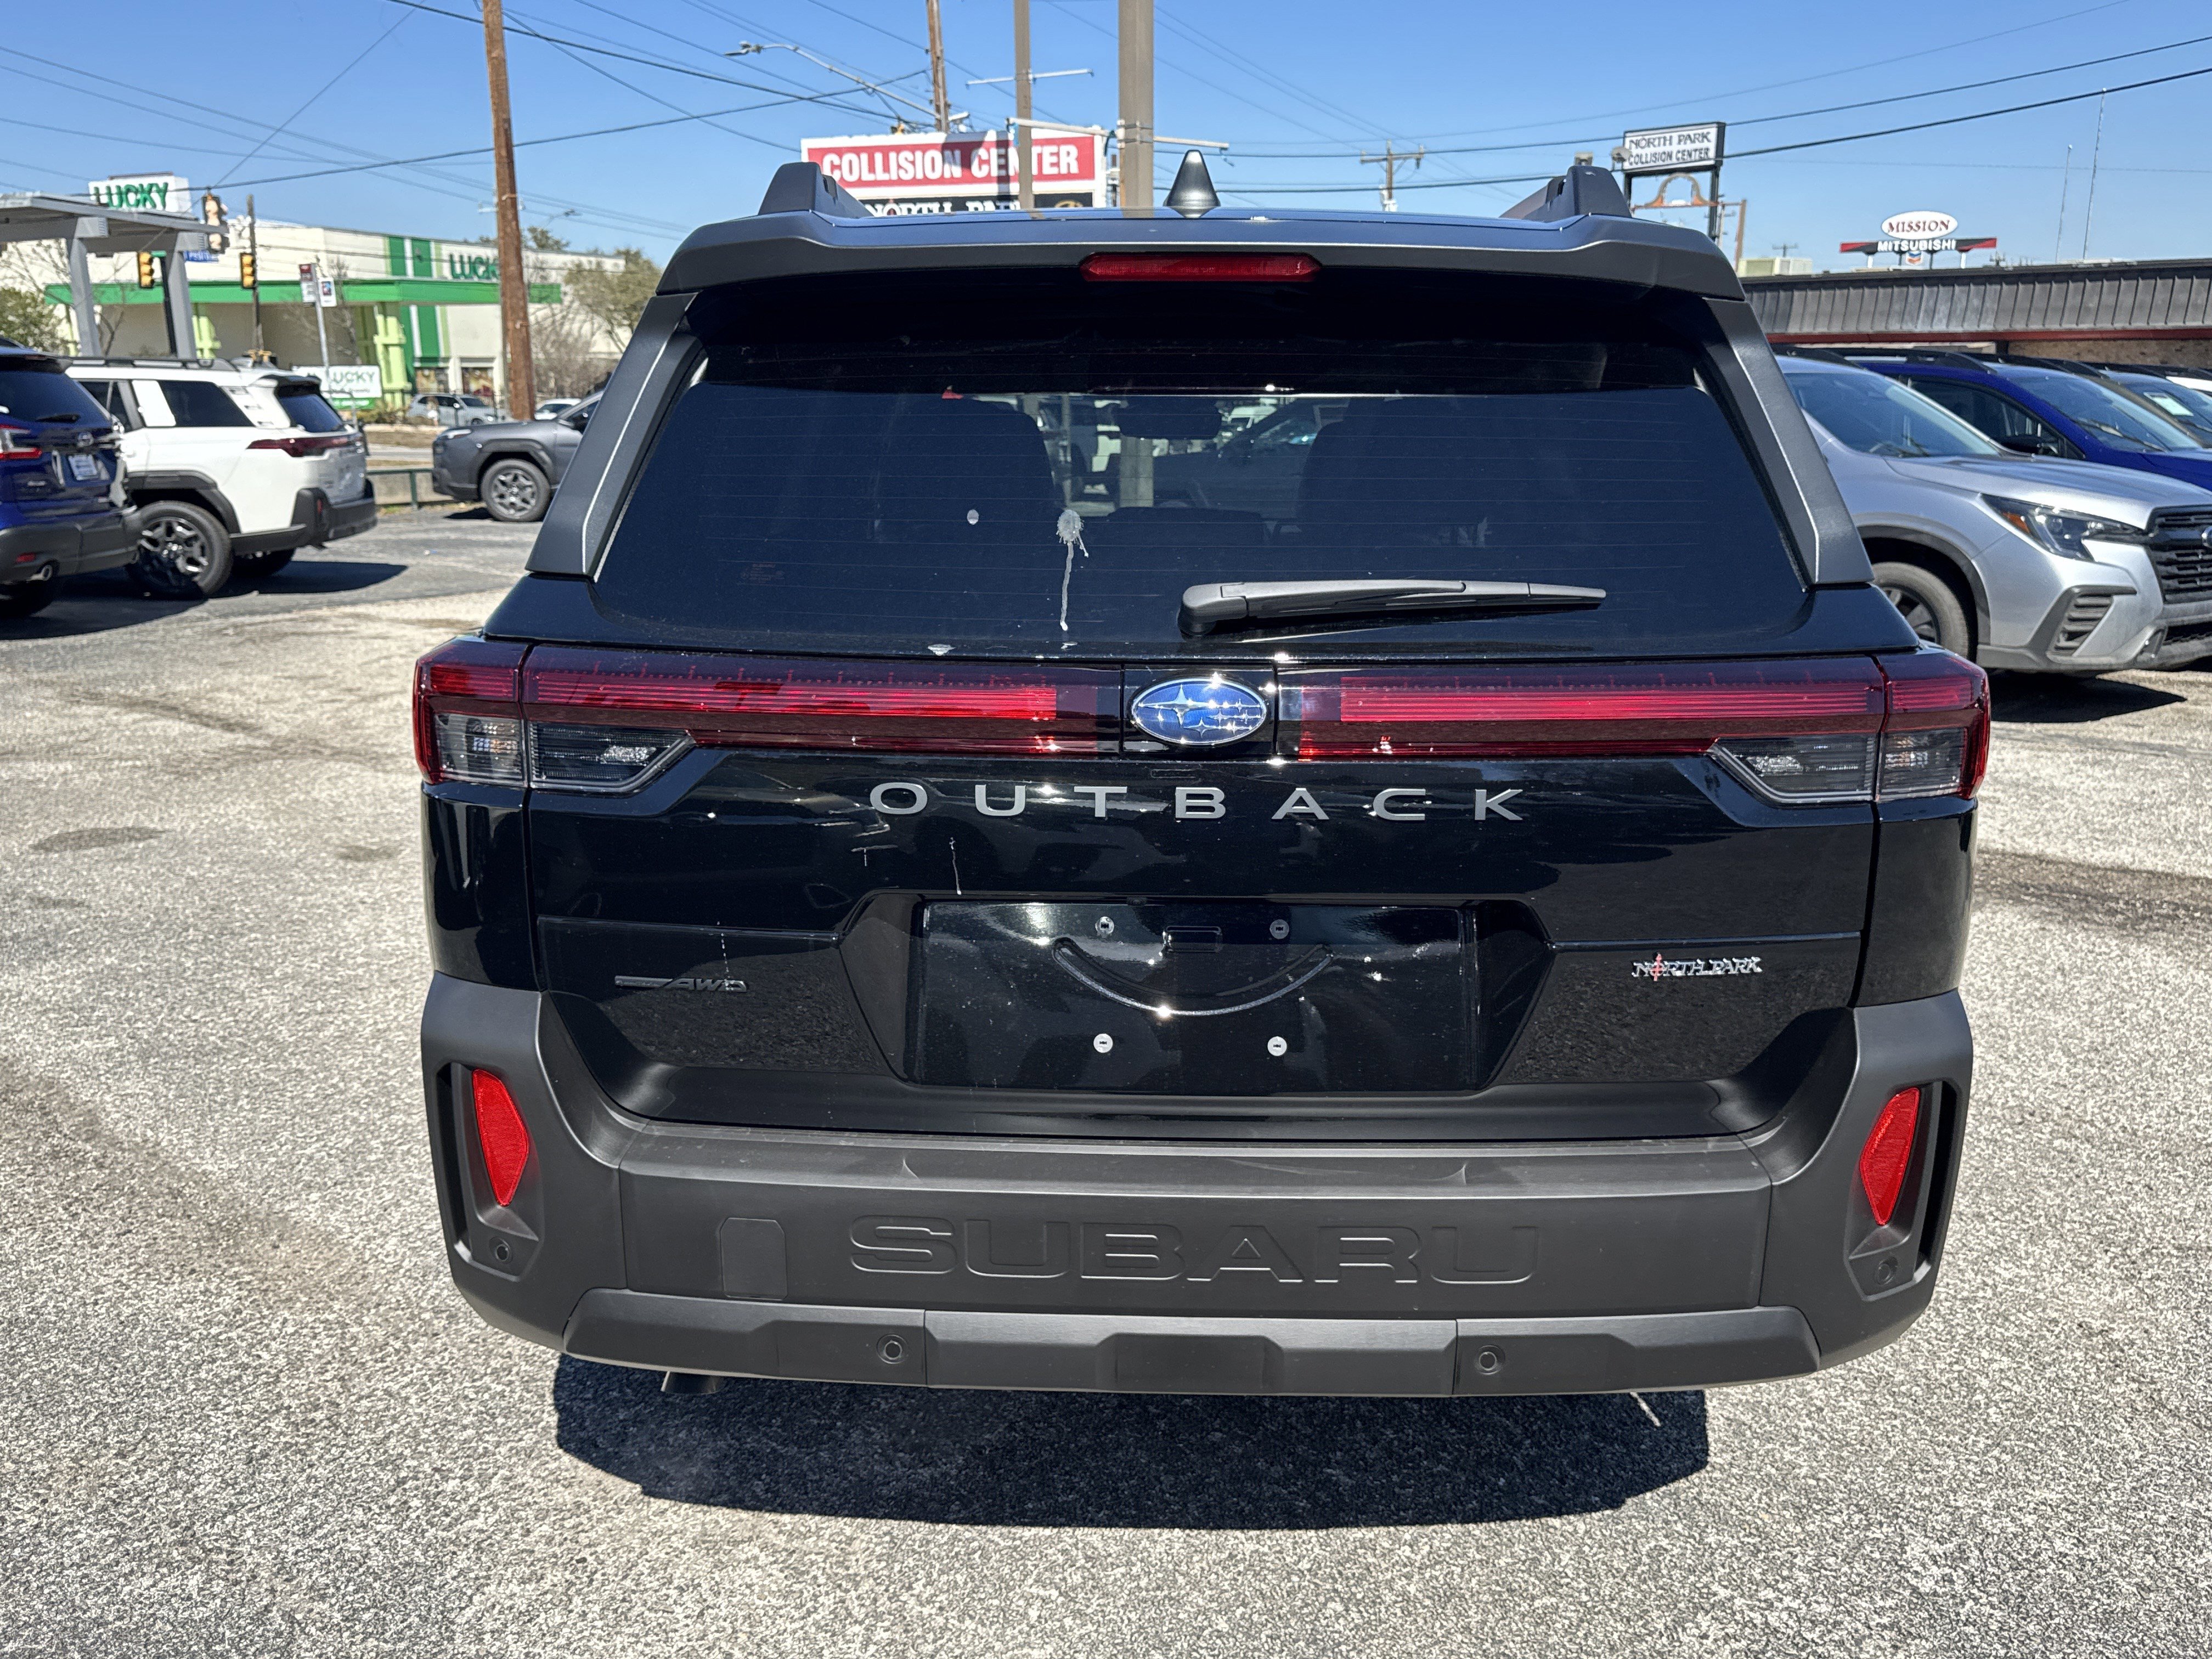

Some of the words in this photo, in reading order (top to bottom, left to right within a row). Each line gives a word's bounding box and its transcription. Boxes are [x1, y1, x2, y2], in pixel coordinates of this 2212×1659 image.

[1629, 136, 1673, 150] NORTH
[1677, 131, 1711, 145] PARK
[822, 150, 962, 182] COLLISION
[1628, 150, 1673, 166] COLLISION
[1675, 147, 1710, 162] CENTER
[93, 182, 168, 209] LUCKY
[1887, 219, 1950, 233] MISSION
[1877, 238, 1956, 252] MITSUBISHI
[870, 782, 1523, 821] OUTBACK
[1632, 953, 1704, 981] NORTH
[1705, 956, 1763, 975] PARK
[663, 978, 747, 992] AWD
[850, 1215, 1538, 1284] SUBARU
